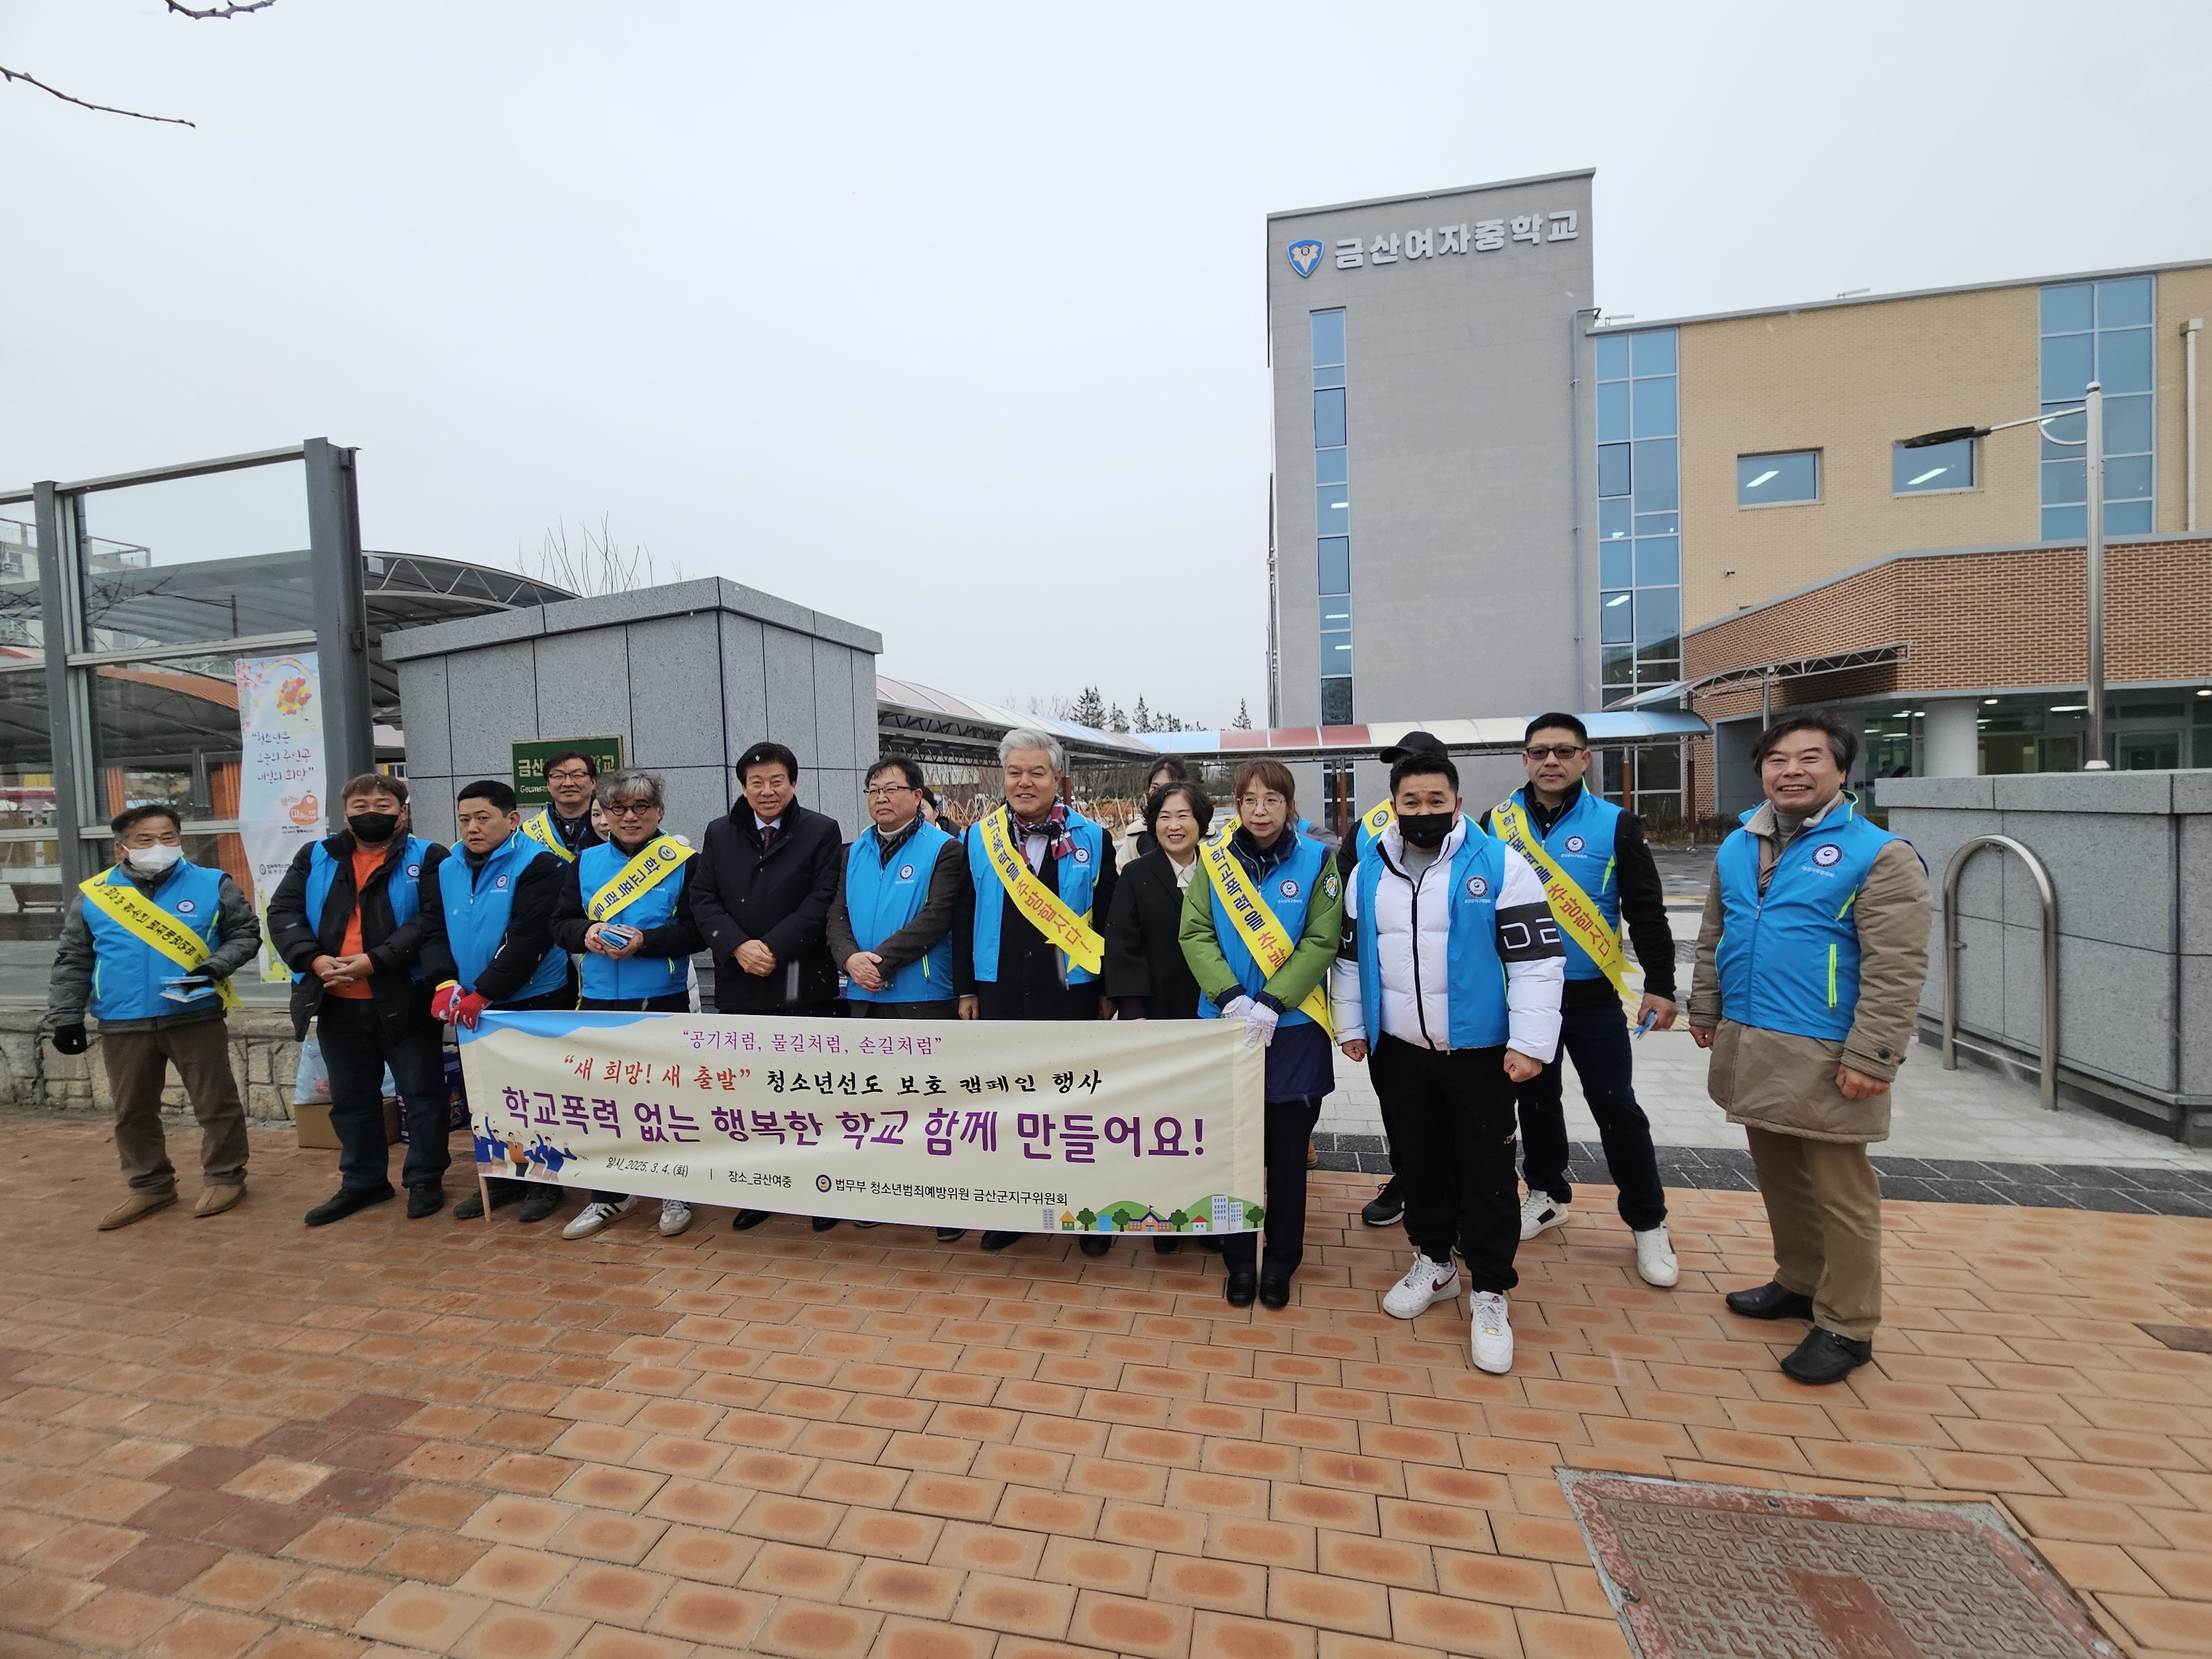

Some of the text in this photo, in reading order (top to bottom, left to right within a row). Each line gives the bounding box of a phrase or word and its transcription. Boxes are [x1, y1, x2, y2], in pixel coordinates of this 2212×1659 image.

[1334, 210, 1579, 270] 금산여자중학교
[258, 749, 311, 765] 오늘의 주인공
[258, 770, 282, 784] 내일의
[987, 815, 1093, 954] 학교폭력을 추방합시다!
[1210, 846, 1266, 932] 학교폭력을
[684, 1031, 941, 1055] “공기처럼, 물길처럼, 손길처럼”
[565, 1055, 1103, 1096] “새 희망! 새 출발” 청소년선도 보호 캠페인 행사
[502, 1086, 1203, 1163] 학교폭력 없는 행복한 학교 함께 만들어요!
[729, 1171, 792, 1188] 장소_금산여중
[836, 1179, 1067, 1206] 법무부 청소년범죄예방위원 금산군지구위원회
